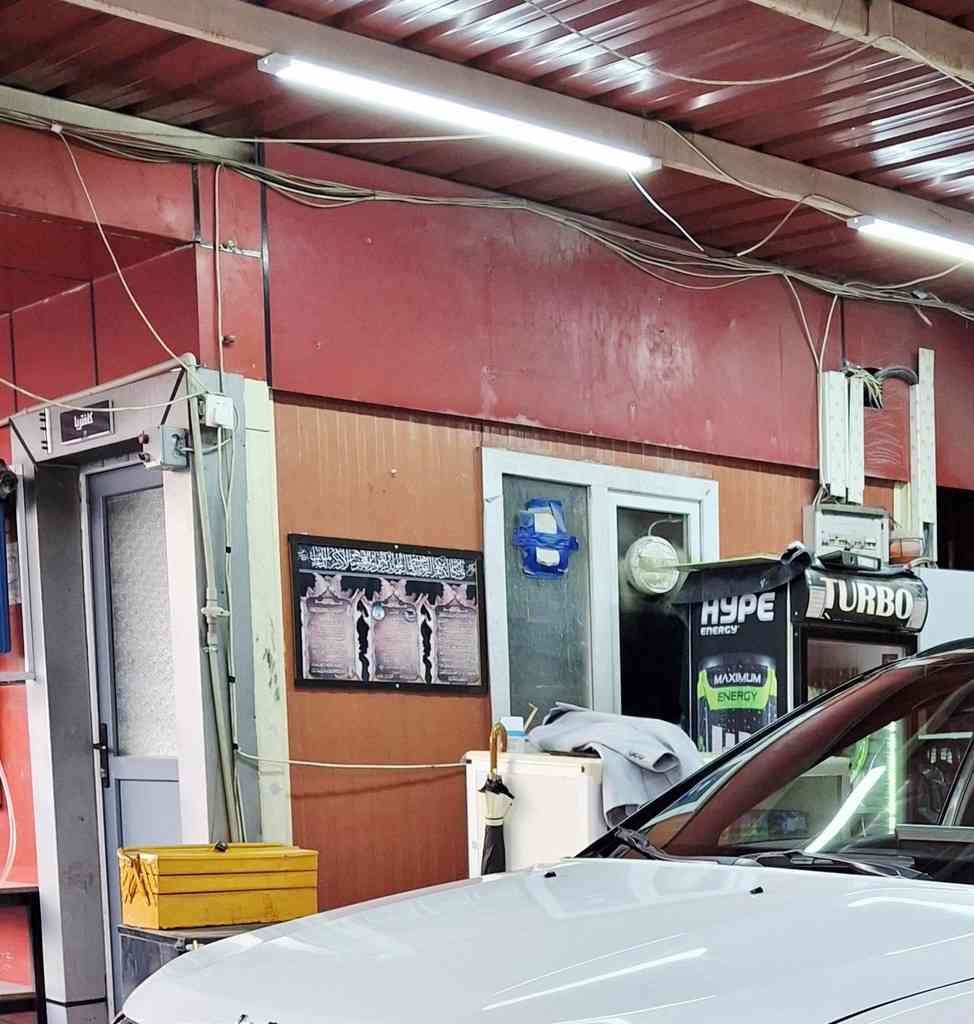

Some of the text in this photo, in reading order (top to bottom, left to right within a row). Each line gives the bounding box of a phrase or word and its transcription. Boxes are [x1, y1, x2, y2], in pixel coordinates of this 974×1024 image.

[820, 577, 914, 620] TURBO
[701, 592, 776, 625] HYPE
[700, 625, 738, 636] ENERGY
[713, 672, 762, 685] MAXIMUM
[717, 690, 758, 702] ENERGY
